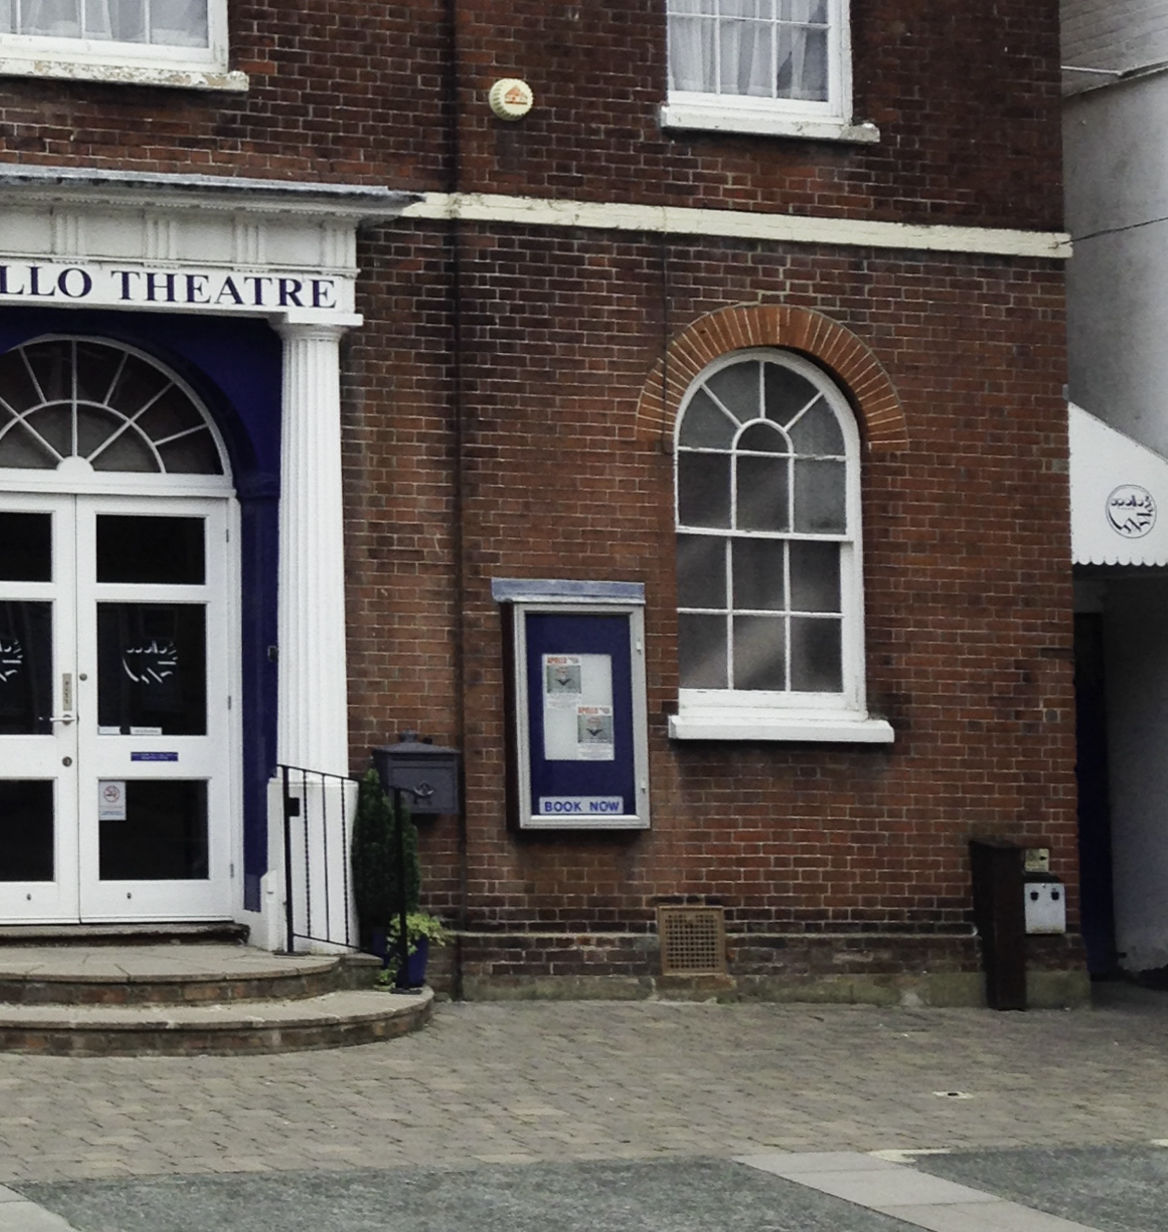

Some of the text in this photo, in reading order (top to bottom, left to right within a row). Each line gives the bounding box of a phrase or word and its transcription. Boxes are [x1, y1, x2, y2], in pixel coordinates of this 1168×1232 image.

[111, 269, 338, 309] THEATRE
[544, 801, 620, 812] BOOK NOW
